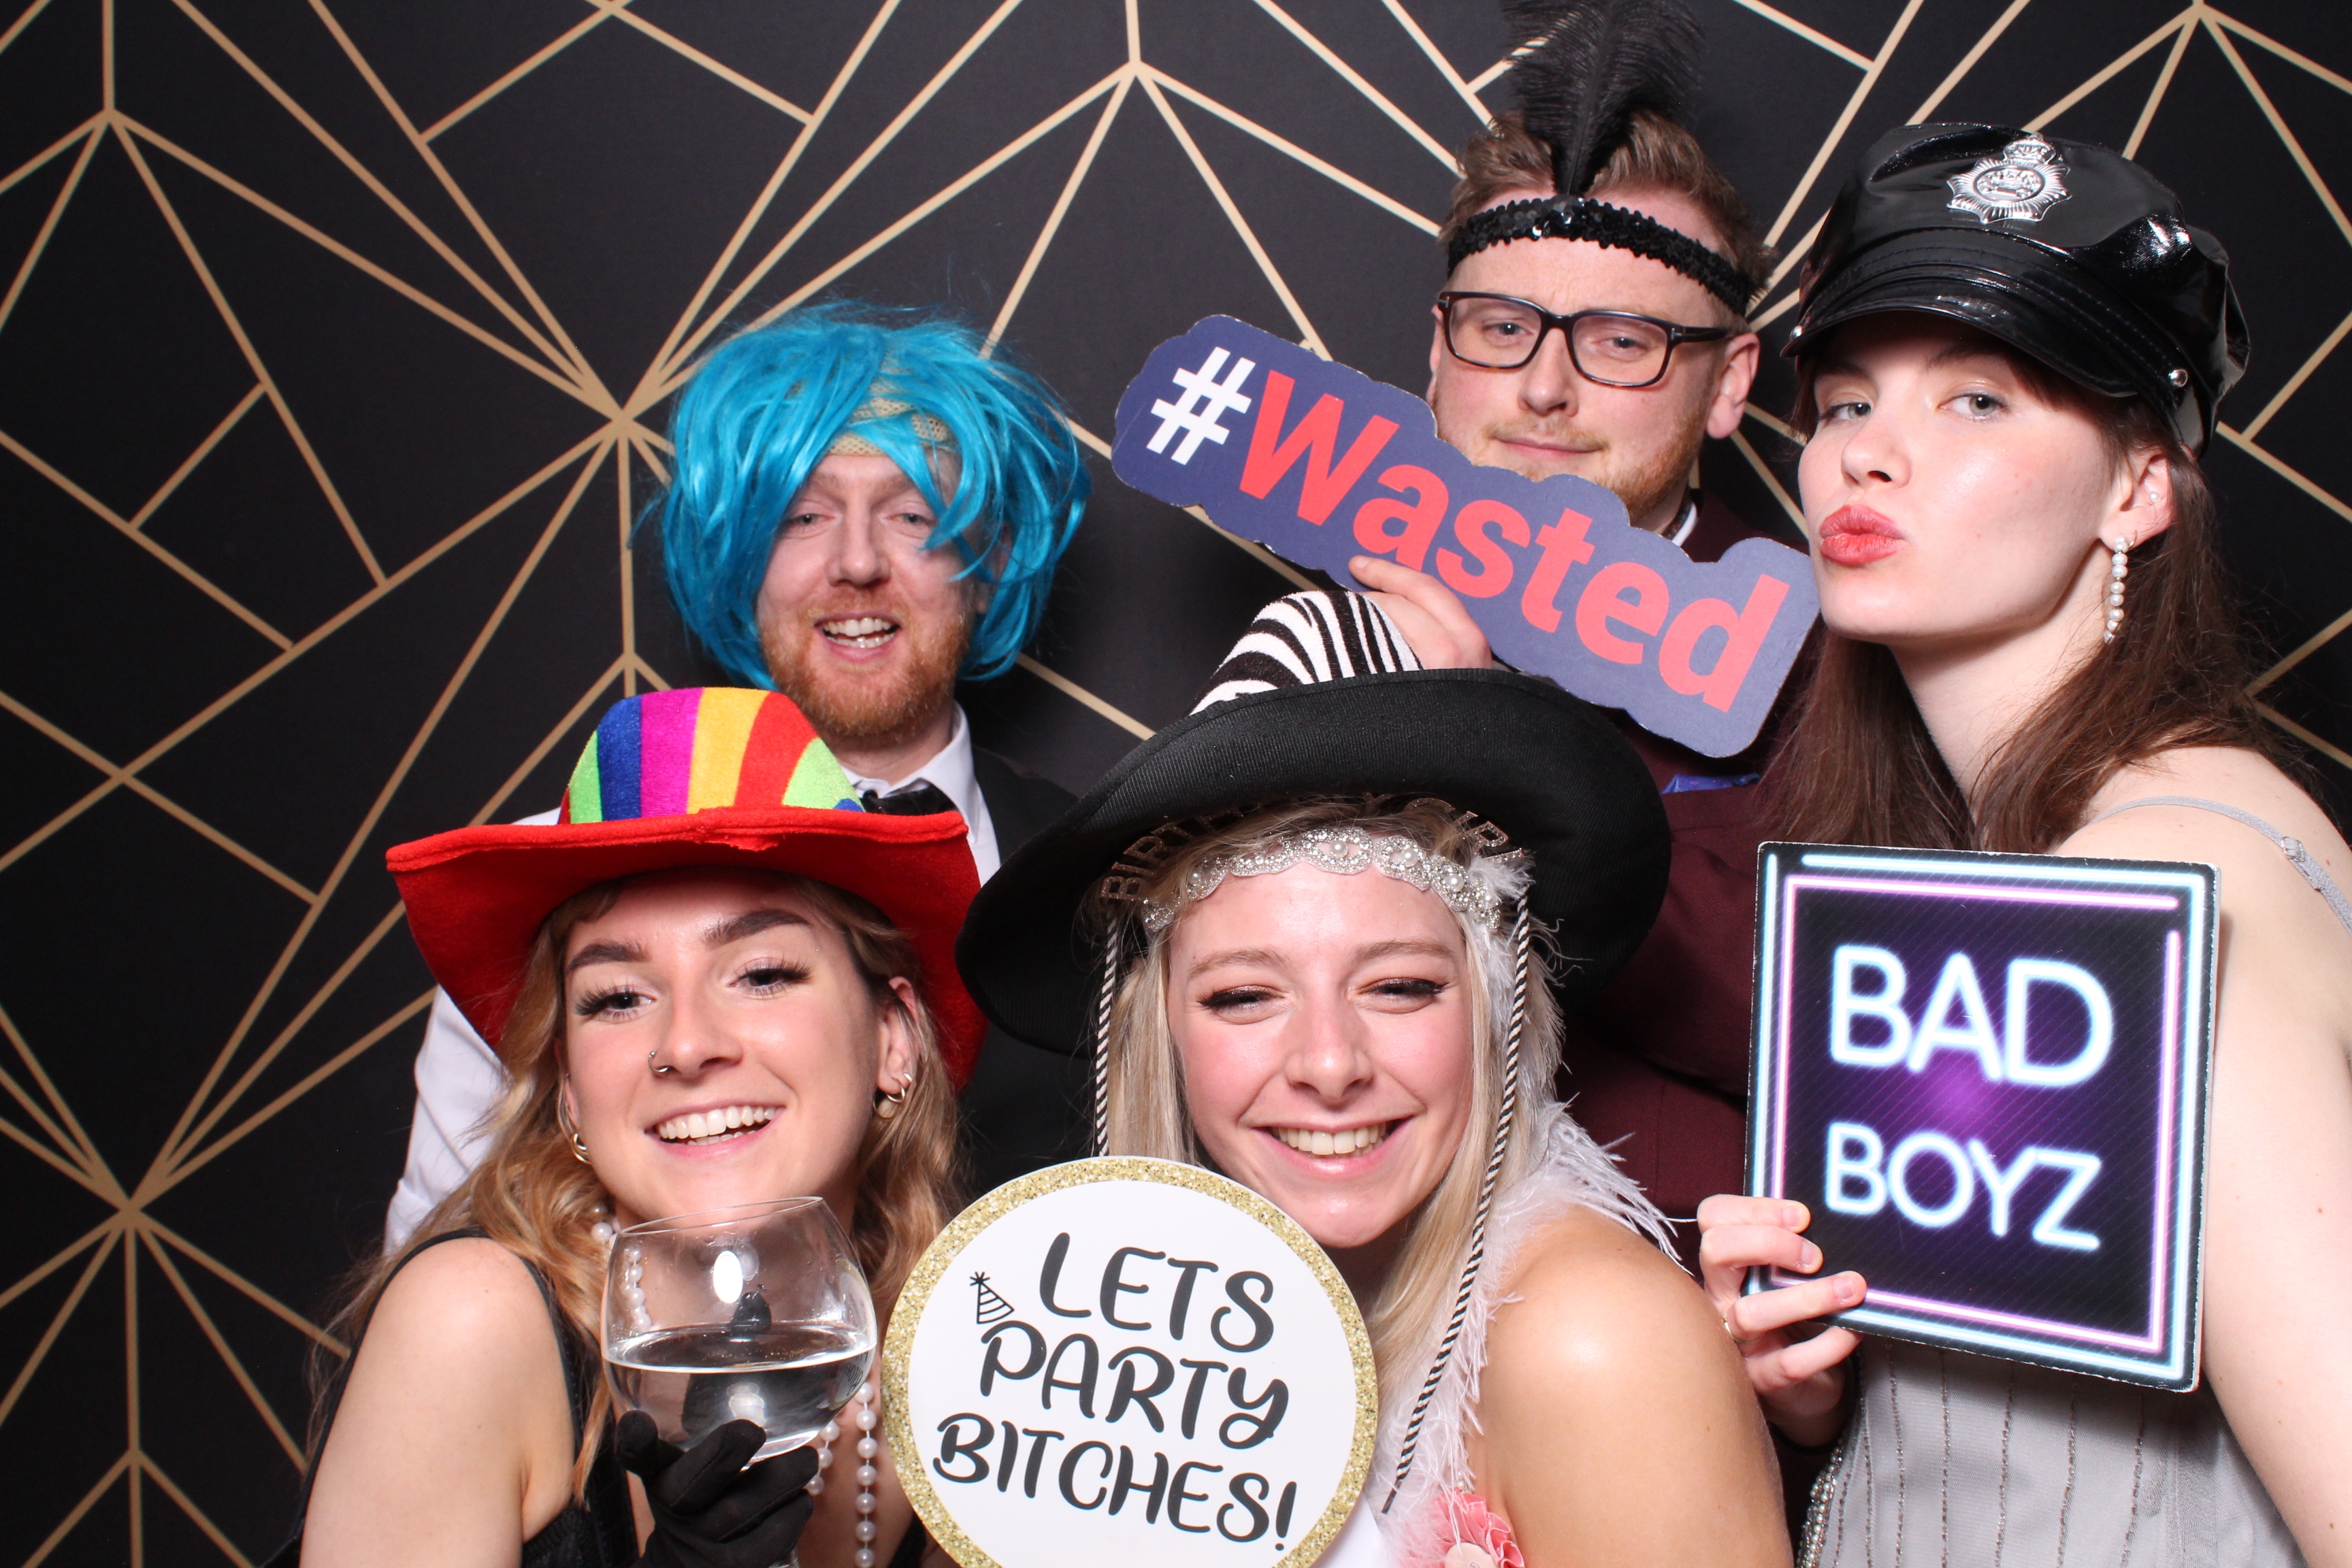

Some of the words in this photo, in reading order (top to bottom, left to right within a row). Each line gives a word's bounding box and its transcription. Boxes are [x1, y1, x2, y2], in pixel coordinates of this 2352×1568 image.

[1147, 347, 1790, 713] #Wasted
[1829, 943, 2114, 1089] BAD
[1824, 1120, 2102, 1252] BOYZ
[1039, 1232, 1274, 1352] LETS
[980, 1320, 1289, 1450] PARTY
[932, 1413, 1297, 1551] BITCHES!
